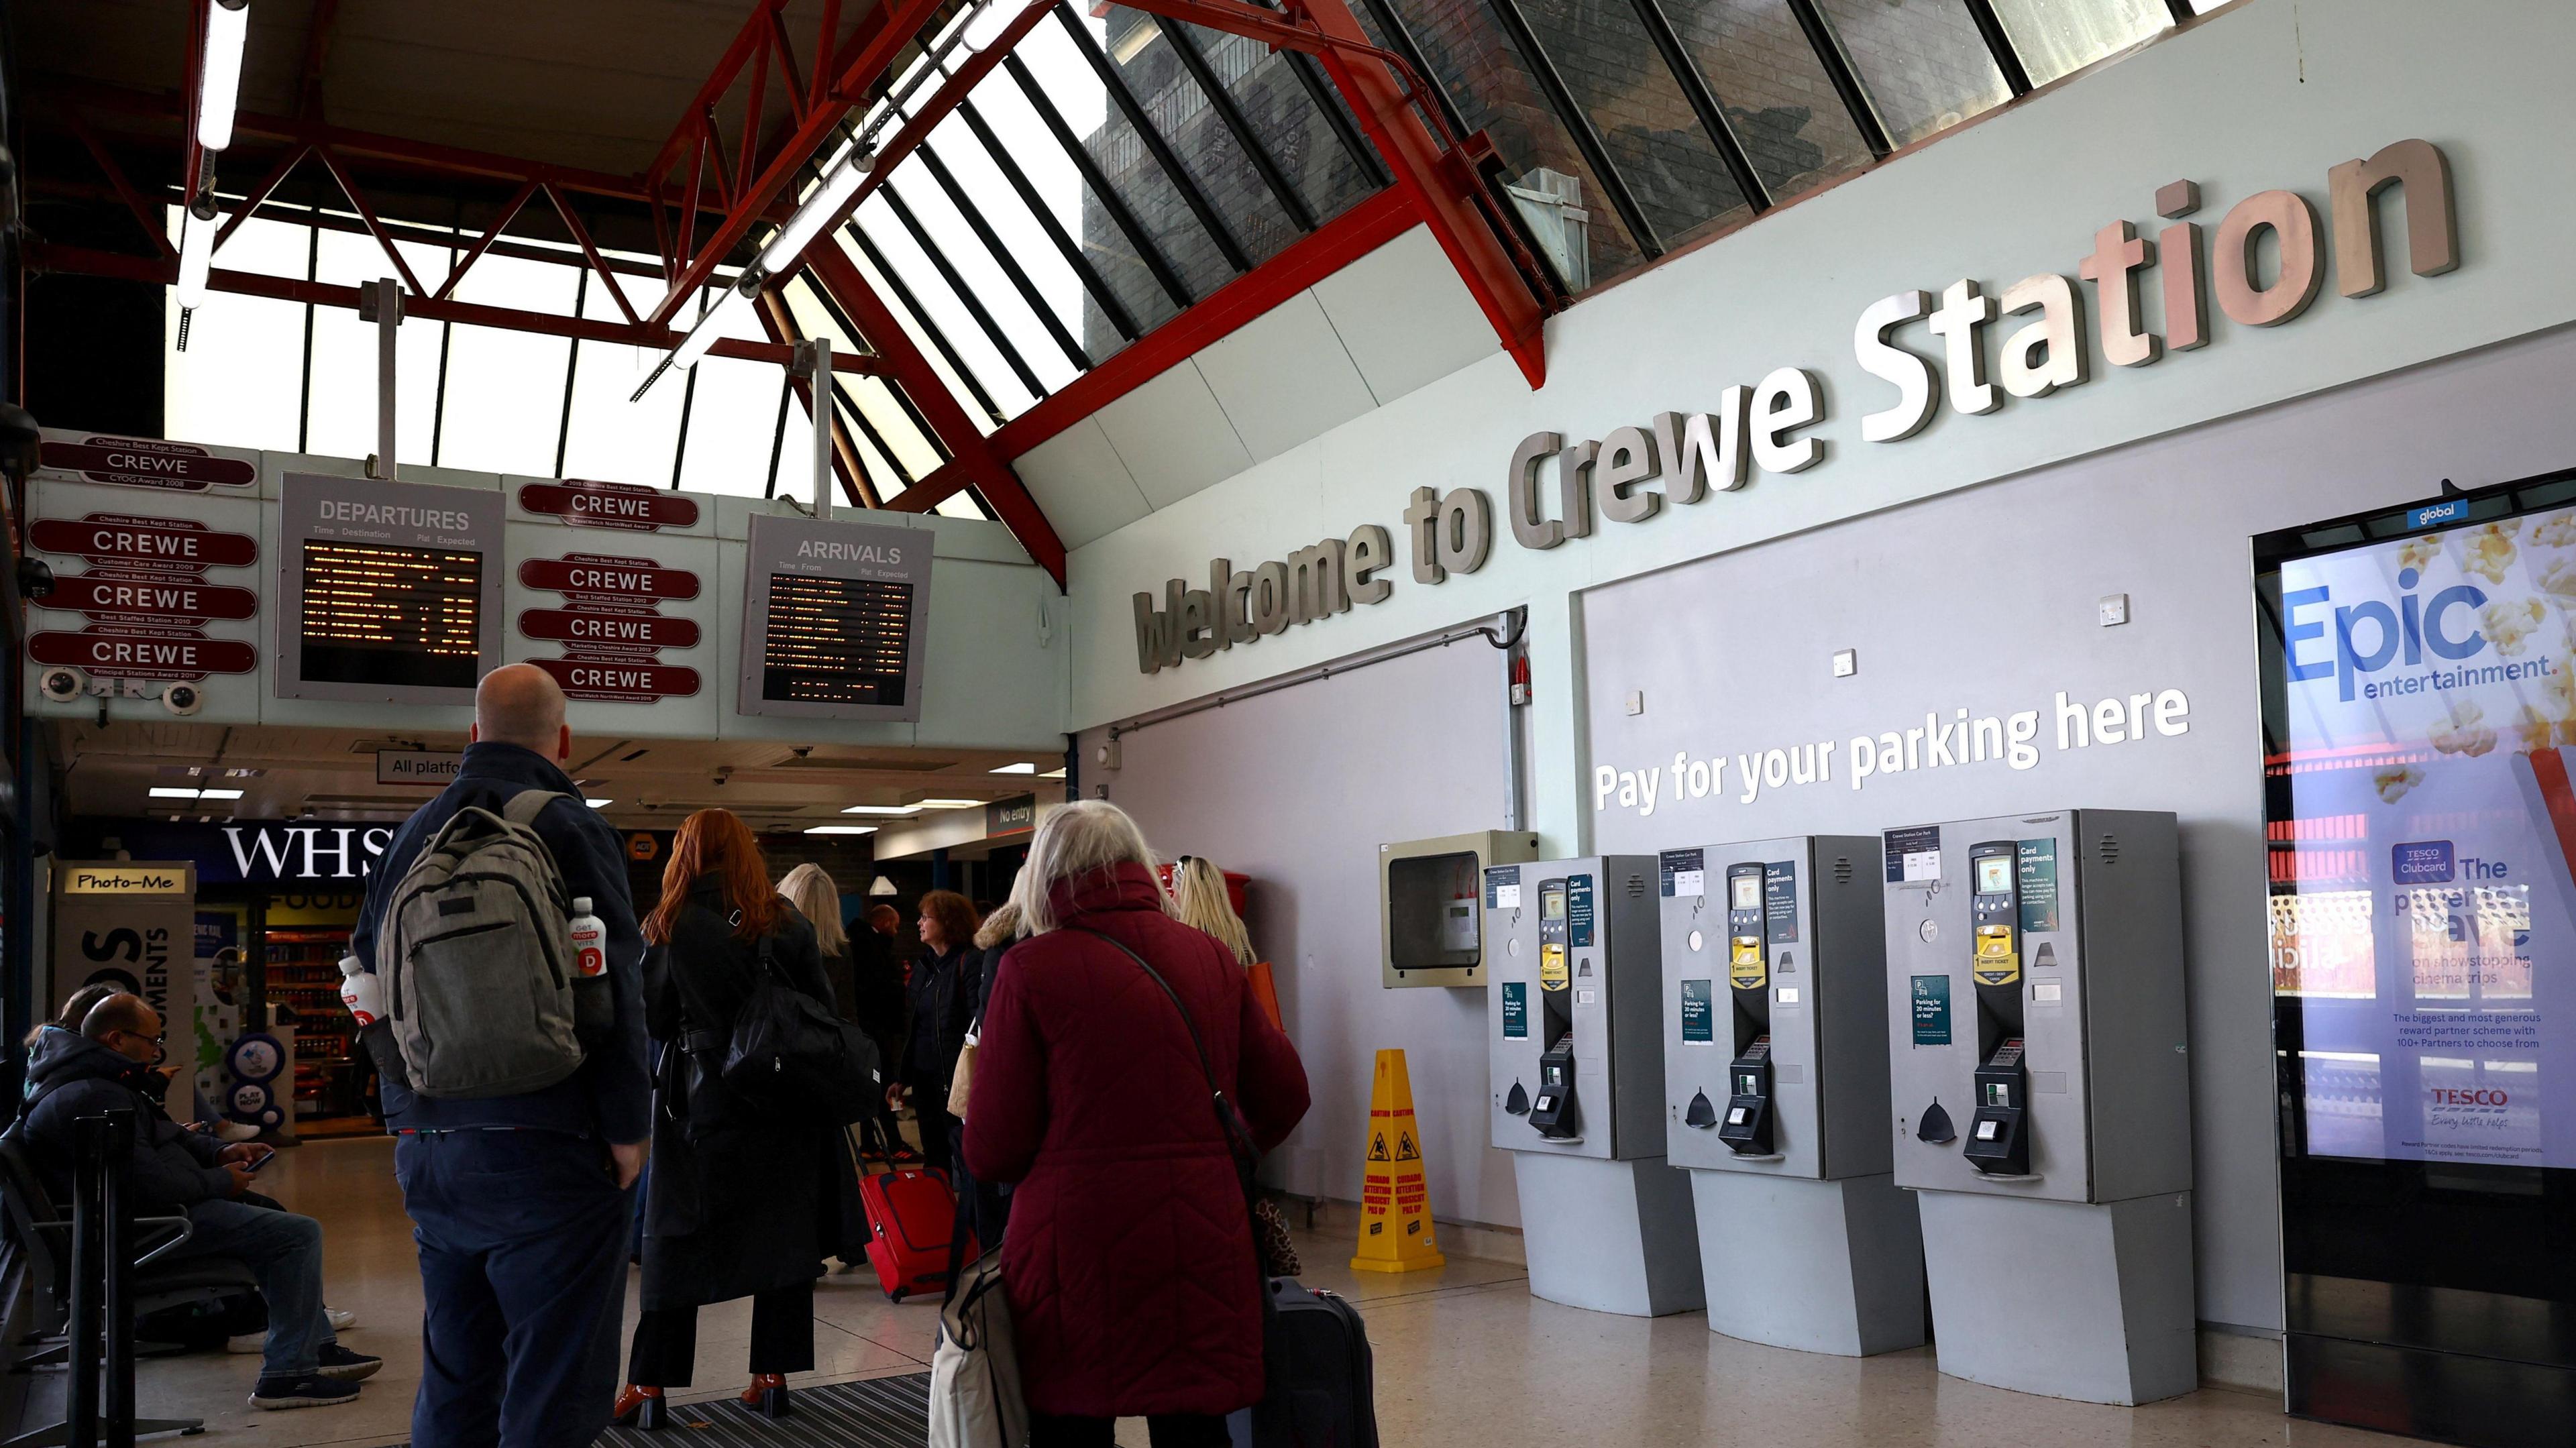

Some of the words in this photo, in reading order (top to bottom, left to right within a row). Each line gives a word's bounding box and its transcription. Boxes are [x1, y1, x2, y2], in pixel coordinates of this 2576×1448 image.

[1132, 524, 1391, 674] Welcome
[1403, 486, 1491, 585] to
[1509, 367, 1823, 549] Crewe
[1854, 137, 2461, 443] Station
[96, 438, 130, 447] Cheshire
[133, 441, 149, 449] Best
[152, 444, 168, 452] Kept
[171, 446, 197, 454] Station
[107, 454, 187, 474] CREWE
[110, 475, 136, 483] CYOG
[138, 478, 163, 486] Award
[166, 480, 184, 488] 2008
[572, 494, 650, 517] CREWE
[132, 517, 148, 525] Best
[320, 500, 470, 531] DEPARTURES
[2419, 504, 2455, 525] global
[93, 531, 198, 557] CREWE
[314, 525, 334, 535] Time
[341, 528, 391, 539] Destination
[437, 535, 476, 547] Expected
[797, 540, 902, 564] ARRIVALS
[778, 561, 796, 570] Time
[801, 562, 822, 571] From
[877, 569, 908, 579] Expected
[570, 569, 653, 592] CREWE
[93, 585, 198, 610] CREWE
[571, 619, 651, 640] CREWE
[2282, 567, 2489, 702] Epic
[92, 642, 197, 665] CREWE
[571, 669, 652, 688] CREWE
[2364, 655, 2557, 700] entertainment.
[1595, 765, 1662, 817] Pay
[1671, 750, 1728, 801] for
[1739, 739, 1837, 804] your
[1849, 708, 2040, 791] parking
[2055, 687, 2190, 751] here
[392, 760, 411, 773] All
[1000, 807, 1010, 824] No
[1012, 805, 1030, 822] entry
[2021, 846, 2037, 854] Card
[2407, 848, 2439, 857] TESCO
[2021, 854, 2053, 865] payments
[2401, 861, 2447, 873] Clubcard
[2021, 865, 2036, 874] only
[2459, 858, 2508, 880] The
[77, 874, 174, 889] Photo-Me
[1768, 875, 1793, 885] payments
[1768, 885, 1780, 893] only
[586, 956, 596, 967] D
[2434, 953, 2530, 969] showstopping
[2413, 973, 2462, 985] cinema
[2467, 971, 2497, 986] trips
[2394, 1014, 2410, 1023] The
[2413, 1014, 2445, 1024] biggest
[2449, 1014, 2465, 1023] and
[2468, 1014, 2492, 1023] most
[2495, 1013, 2541, 1024] generous
[2400, 1027, 2432, 1035] reward
[2434, 1027, 2470, 1037] partner
[2473, 1027, 2511, 1035] scheme
[2514, 1026, 2535, 1035] with
[2398, 1039, 2419, 1047] 100+
[2422, 1039, 2461, 1048] Partners
[2464, 1040, 2475, 1048] to
[2477, 1039, 2513, 1048] choose
[2515, 1039, 2539, 1048] from
[239, 1091, 260, 1101] PLAY
[240, 1098, 261, 1107] NOW
[2431, 1089, 2508, 1105] TESCO
